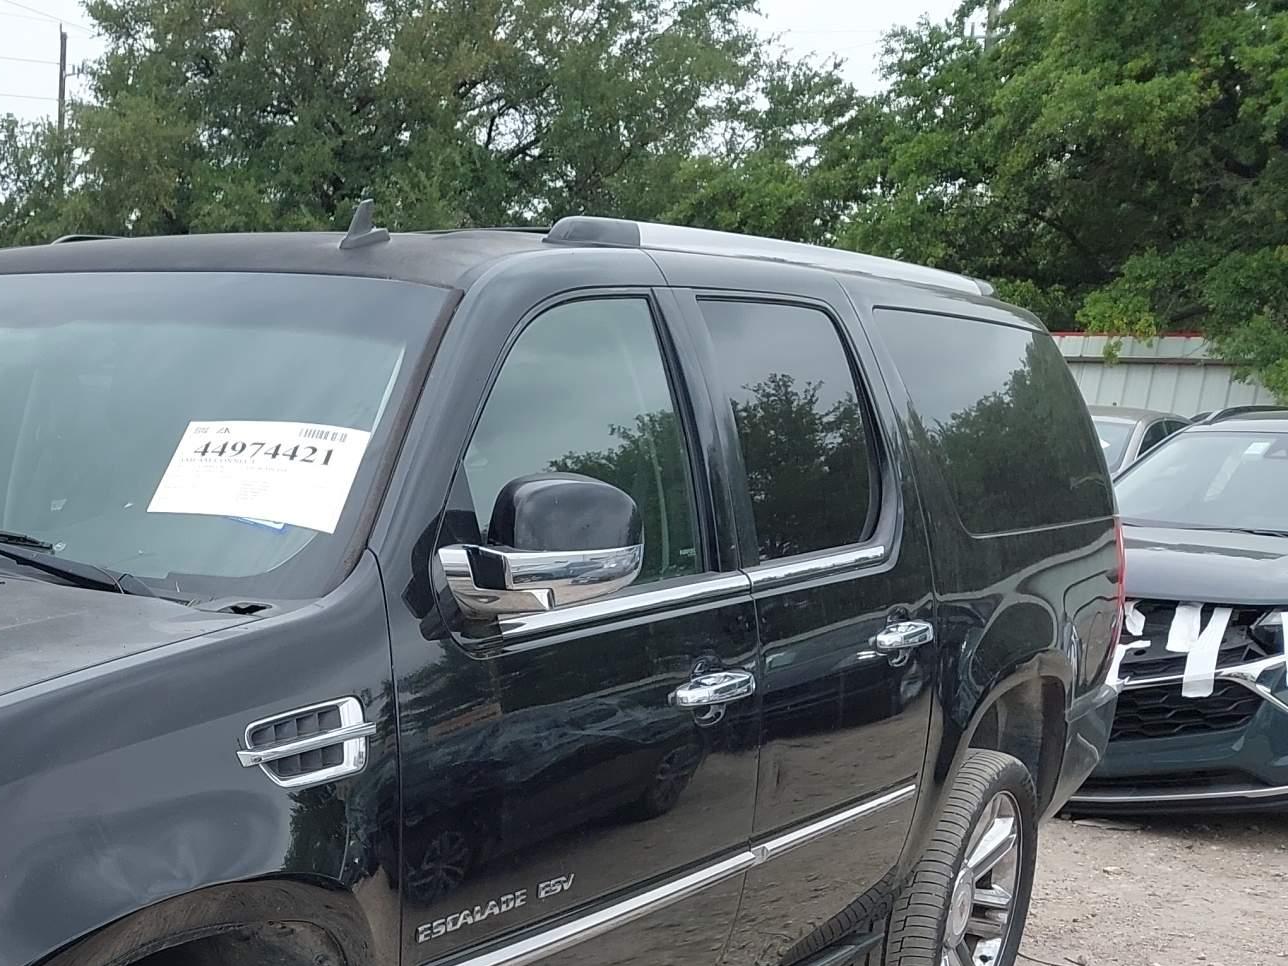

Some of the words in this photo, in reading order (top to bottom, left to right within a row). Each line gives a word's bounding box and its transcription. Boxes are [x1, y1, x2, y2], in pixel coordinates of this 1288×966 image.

[193, 440, 334, 466] 44974421
[416, 889, 527, 943] ESCALADE
[537, 873, 574, 899] ESV
